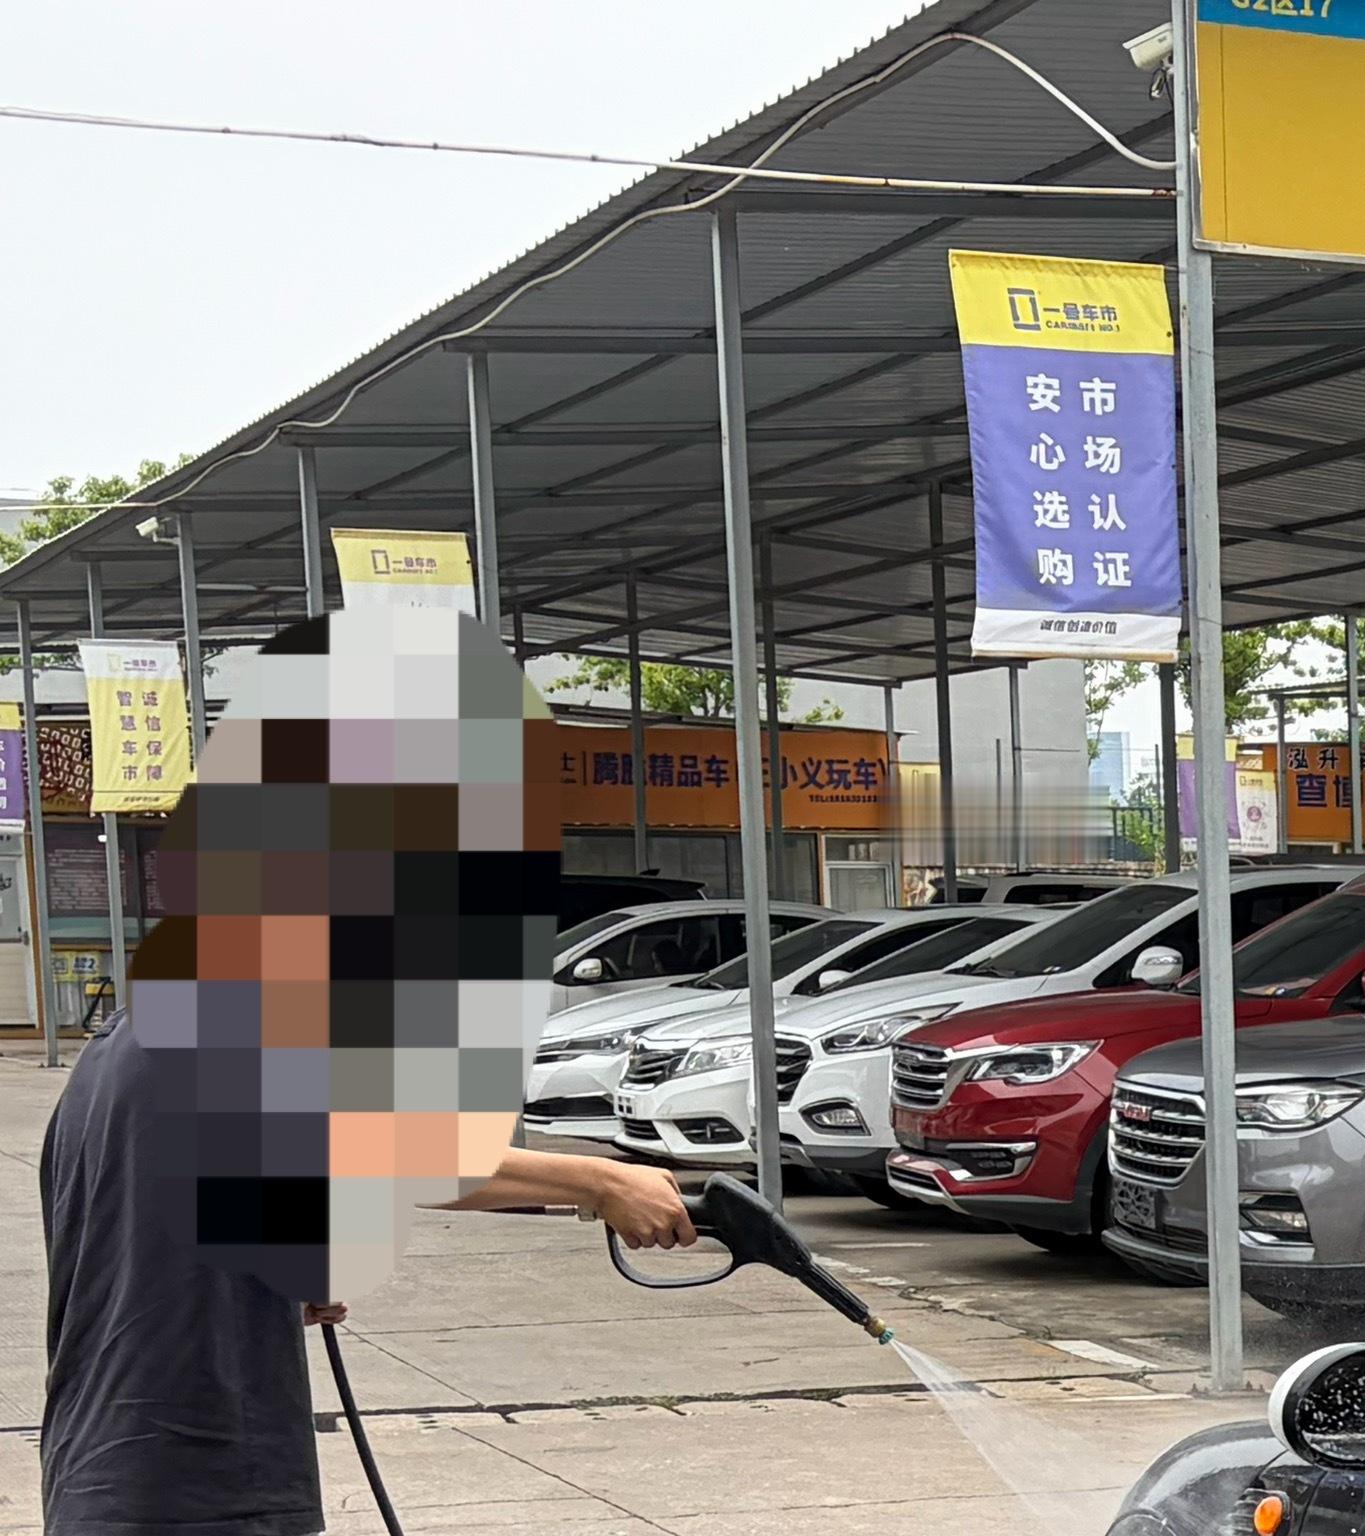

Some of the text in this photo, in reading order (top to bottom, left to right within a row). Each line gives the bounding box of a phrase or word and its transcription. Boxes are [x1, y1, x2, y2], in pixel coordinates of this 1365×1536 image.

[1025, 372, 1075, 586] 安心选购
[1079, 376, 1132, 587] 市场认证
